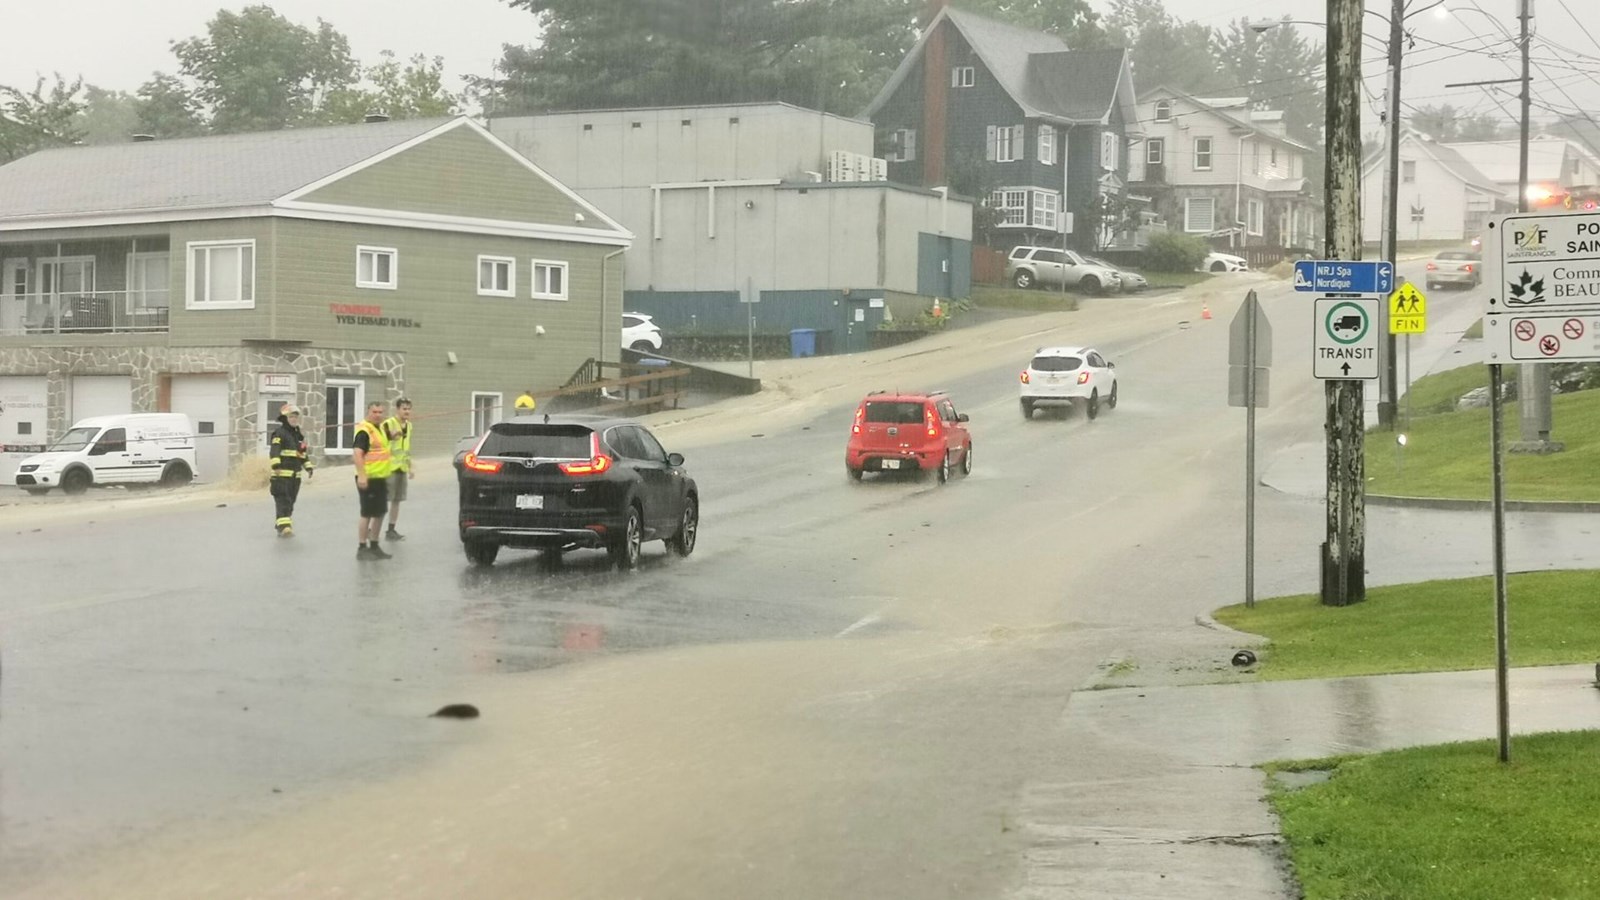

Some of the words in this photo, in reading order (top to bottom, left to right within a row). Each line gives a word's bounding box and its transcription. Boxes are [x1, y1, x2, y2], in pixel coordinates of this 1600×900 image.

[1317, 266, 1334, 276] NRJ
[1336, 266, 1352, 278] Spa
[1317, 279, 1351, 289] Nordique
[1381, 280, 1388, 289] 9
[1554, 283, 1600, 297] BEAU
[1396, 320, 1419, 329] FIN
[1319, 347, 1374, 359] TRANSIT
